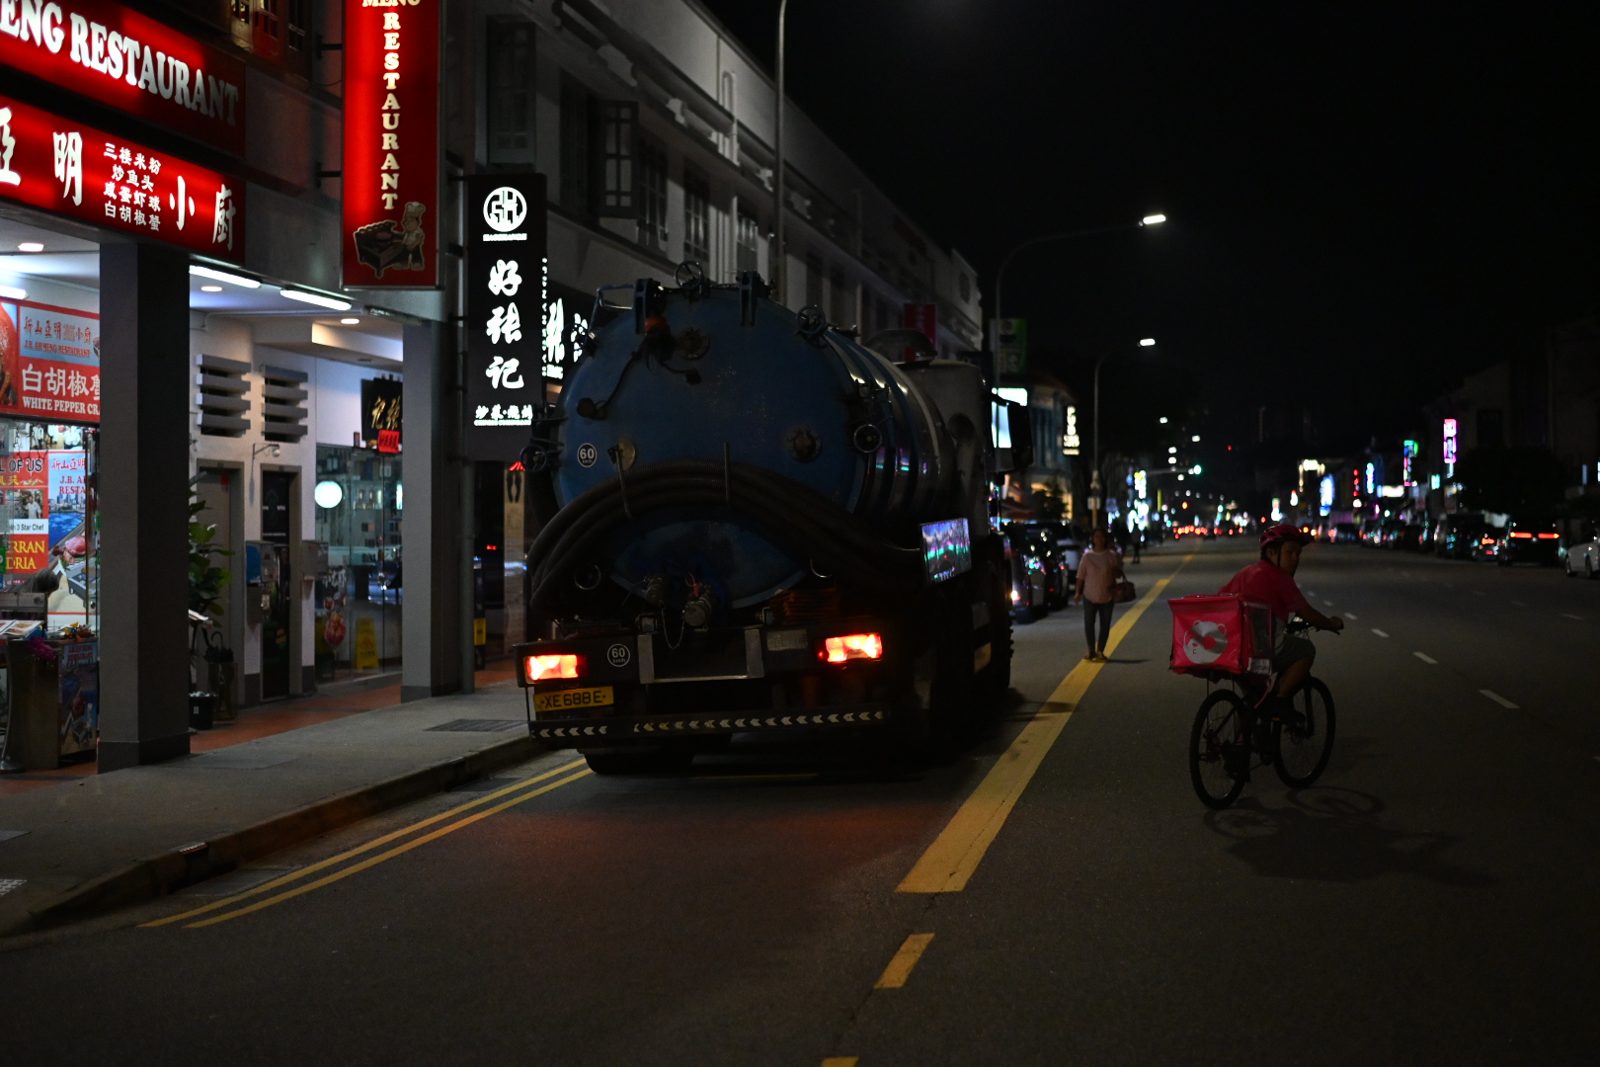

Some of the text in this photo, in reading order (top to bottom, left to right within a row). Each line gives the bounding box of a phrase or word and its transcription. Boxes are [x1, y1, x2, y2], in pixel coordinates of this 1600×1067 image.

[70, 12, 239, 126] RESTAURANT
[381, 12, 402, 210] RESTAURANT
[23, 397, 100, 416] WHITE PEPPER CR
[580, 448, 594, 459] 60
[27, 458, 43, 472] US
[612, 647, 625, 658] 60
